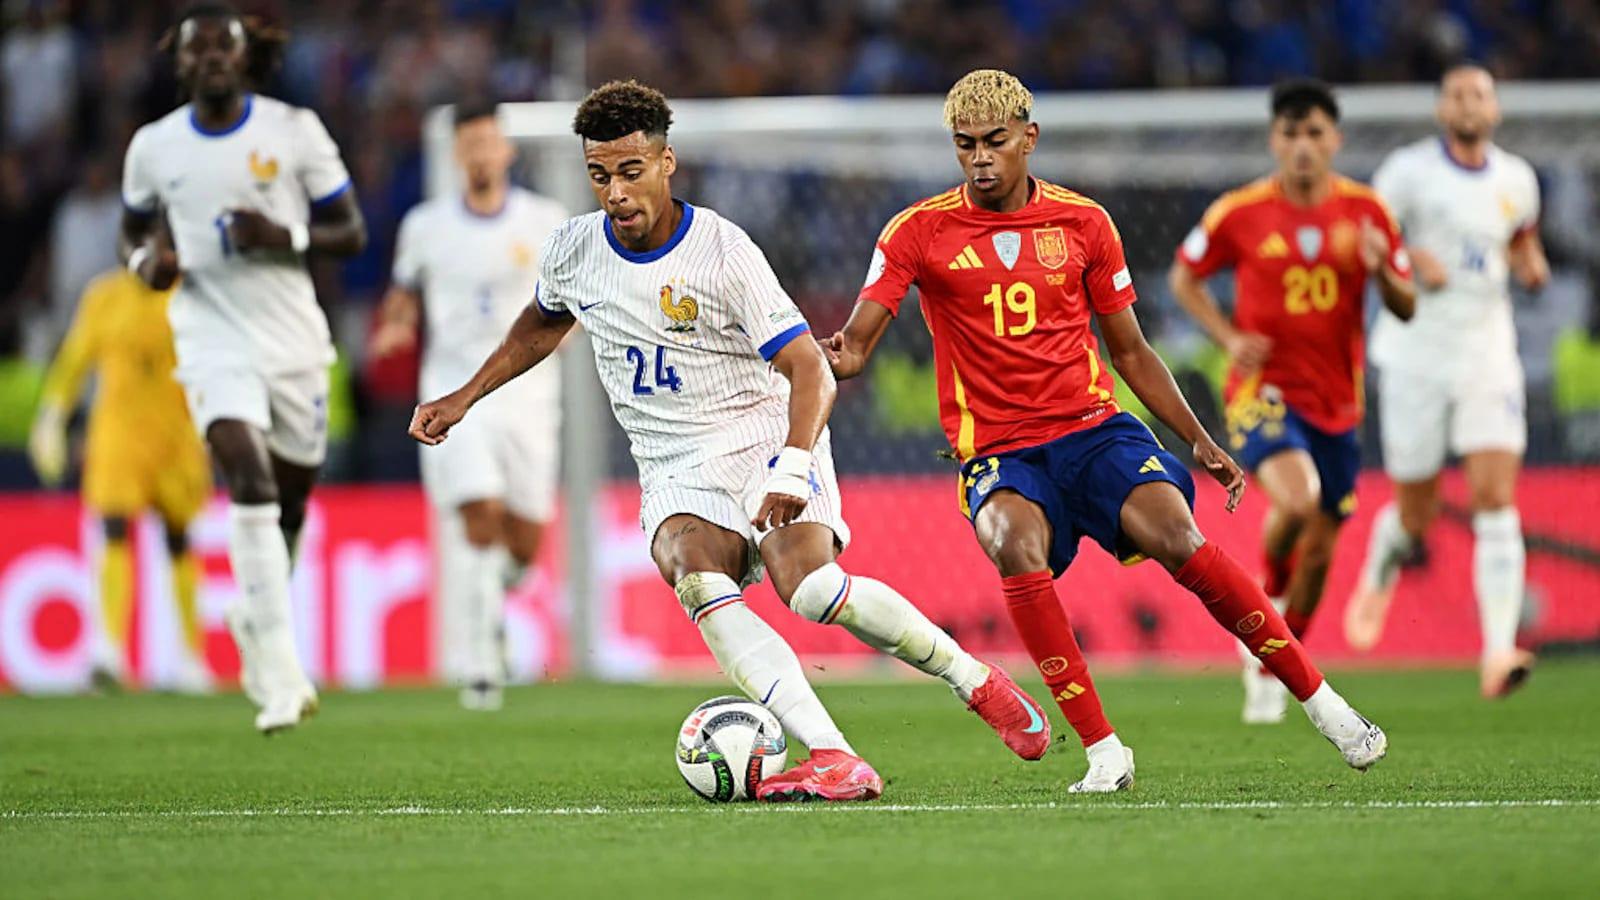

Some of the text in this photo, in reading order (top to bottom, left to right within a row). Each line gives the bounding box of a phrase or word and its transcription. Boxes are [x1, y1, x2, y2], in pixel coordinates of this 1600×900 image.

[983, 281, 1037, 337] 19
[1284, 265, 1339, 314] 20
[627, 345, 682, 396] 24
